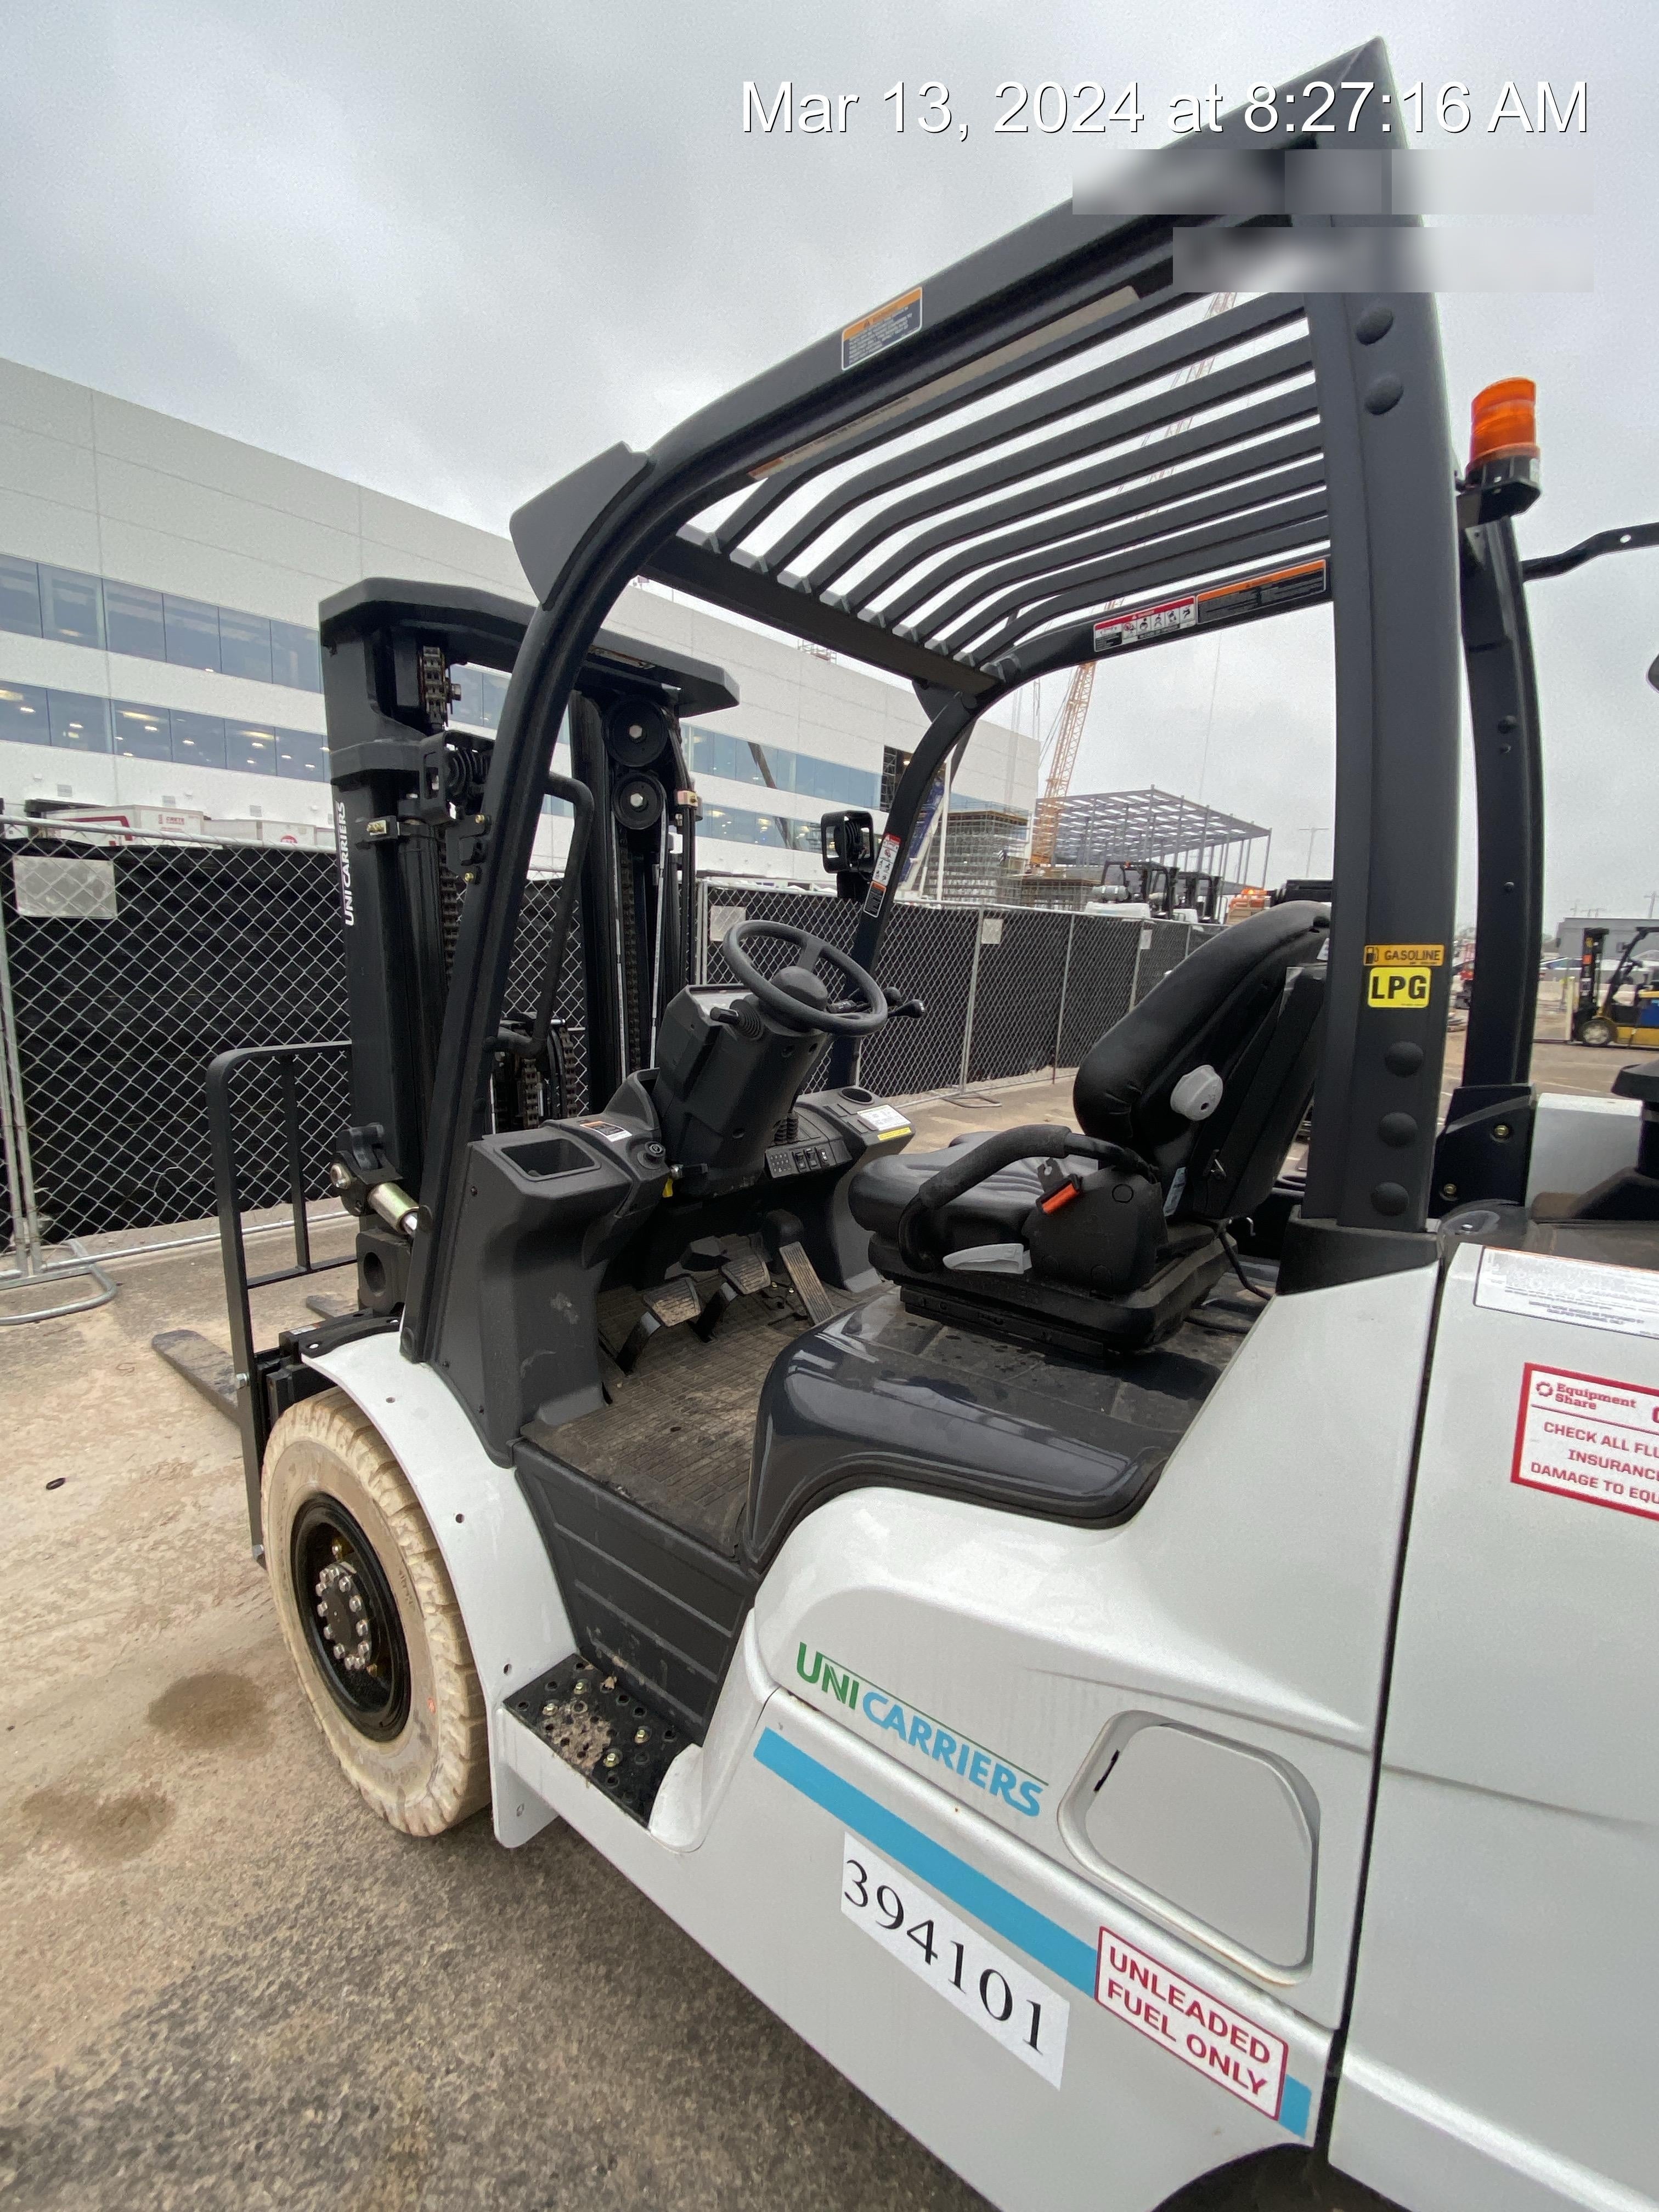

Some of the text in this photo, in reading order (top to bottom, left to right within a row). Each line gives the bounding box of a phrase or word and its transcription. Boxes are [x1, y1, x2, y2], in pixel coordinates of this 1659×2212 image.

[1384, 950, 1441, 961] GASOLINE
[1371, 975, 1427, 999] LPG
[1555, 1393, 1598, 1410] Share
[1556, 1382, 1638, 1409] Equipment
[1543, 1421, 1598, 1444] CHECK
[1600, 1434, 1630, 1452] ALL
[1531, 1462, 1599, 1489] DAMAGE
[1603, 1479, 1625, 1495] TO
[1567, 1448, 1659, 1482] INSURANC
[844, 1859, 1043, 2056] 394101
[1110, 1945, 1271, 2064] UNLEADED
[1107, 1977, 1268, 2096] FUEL ONLY
